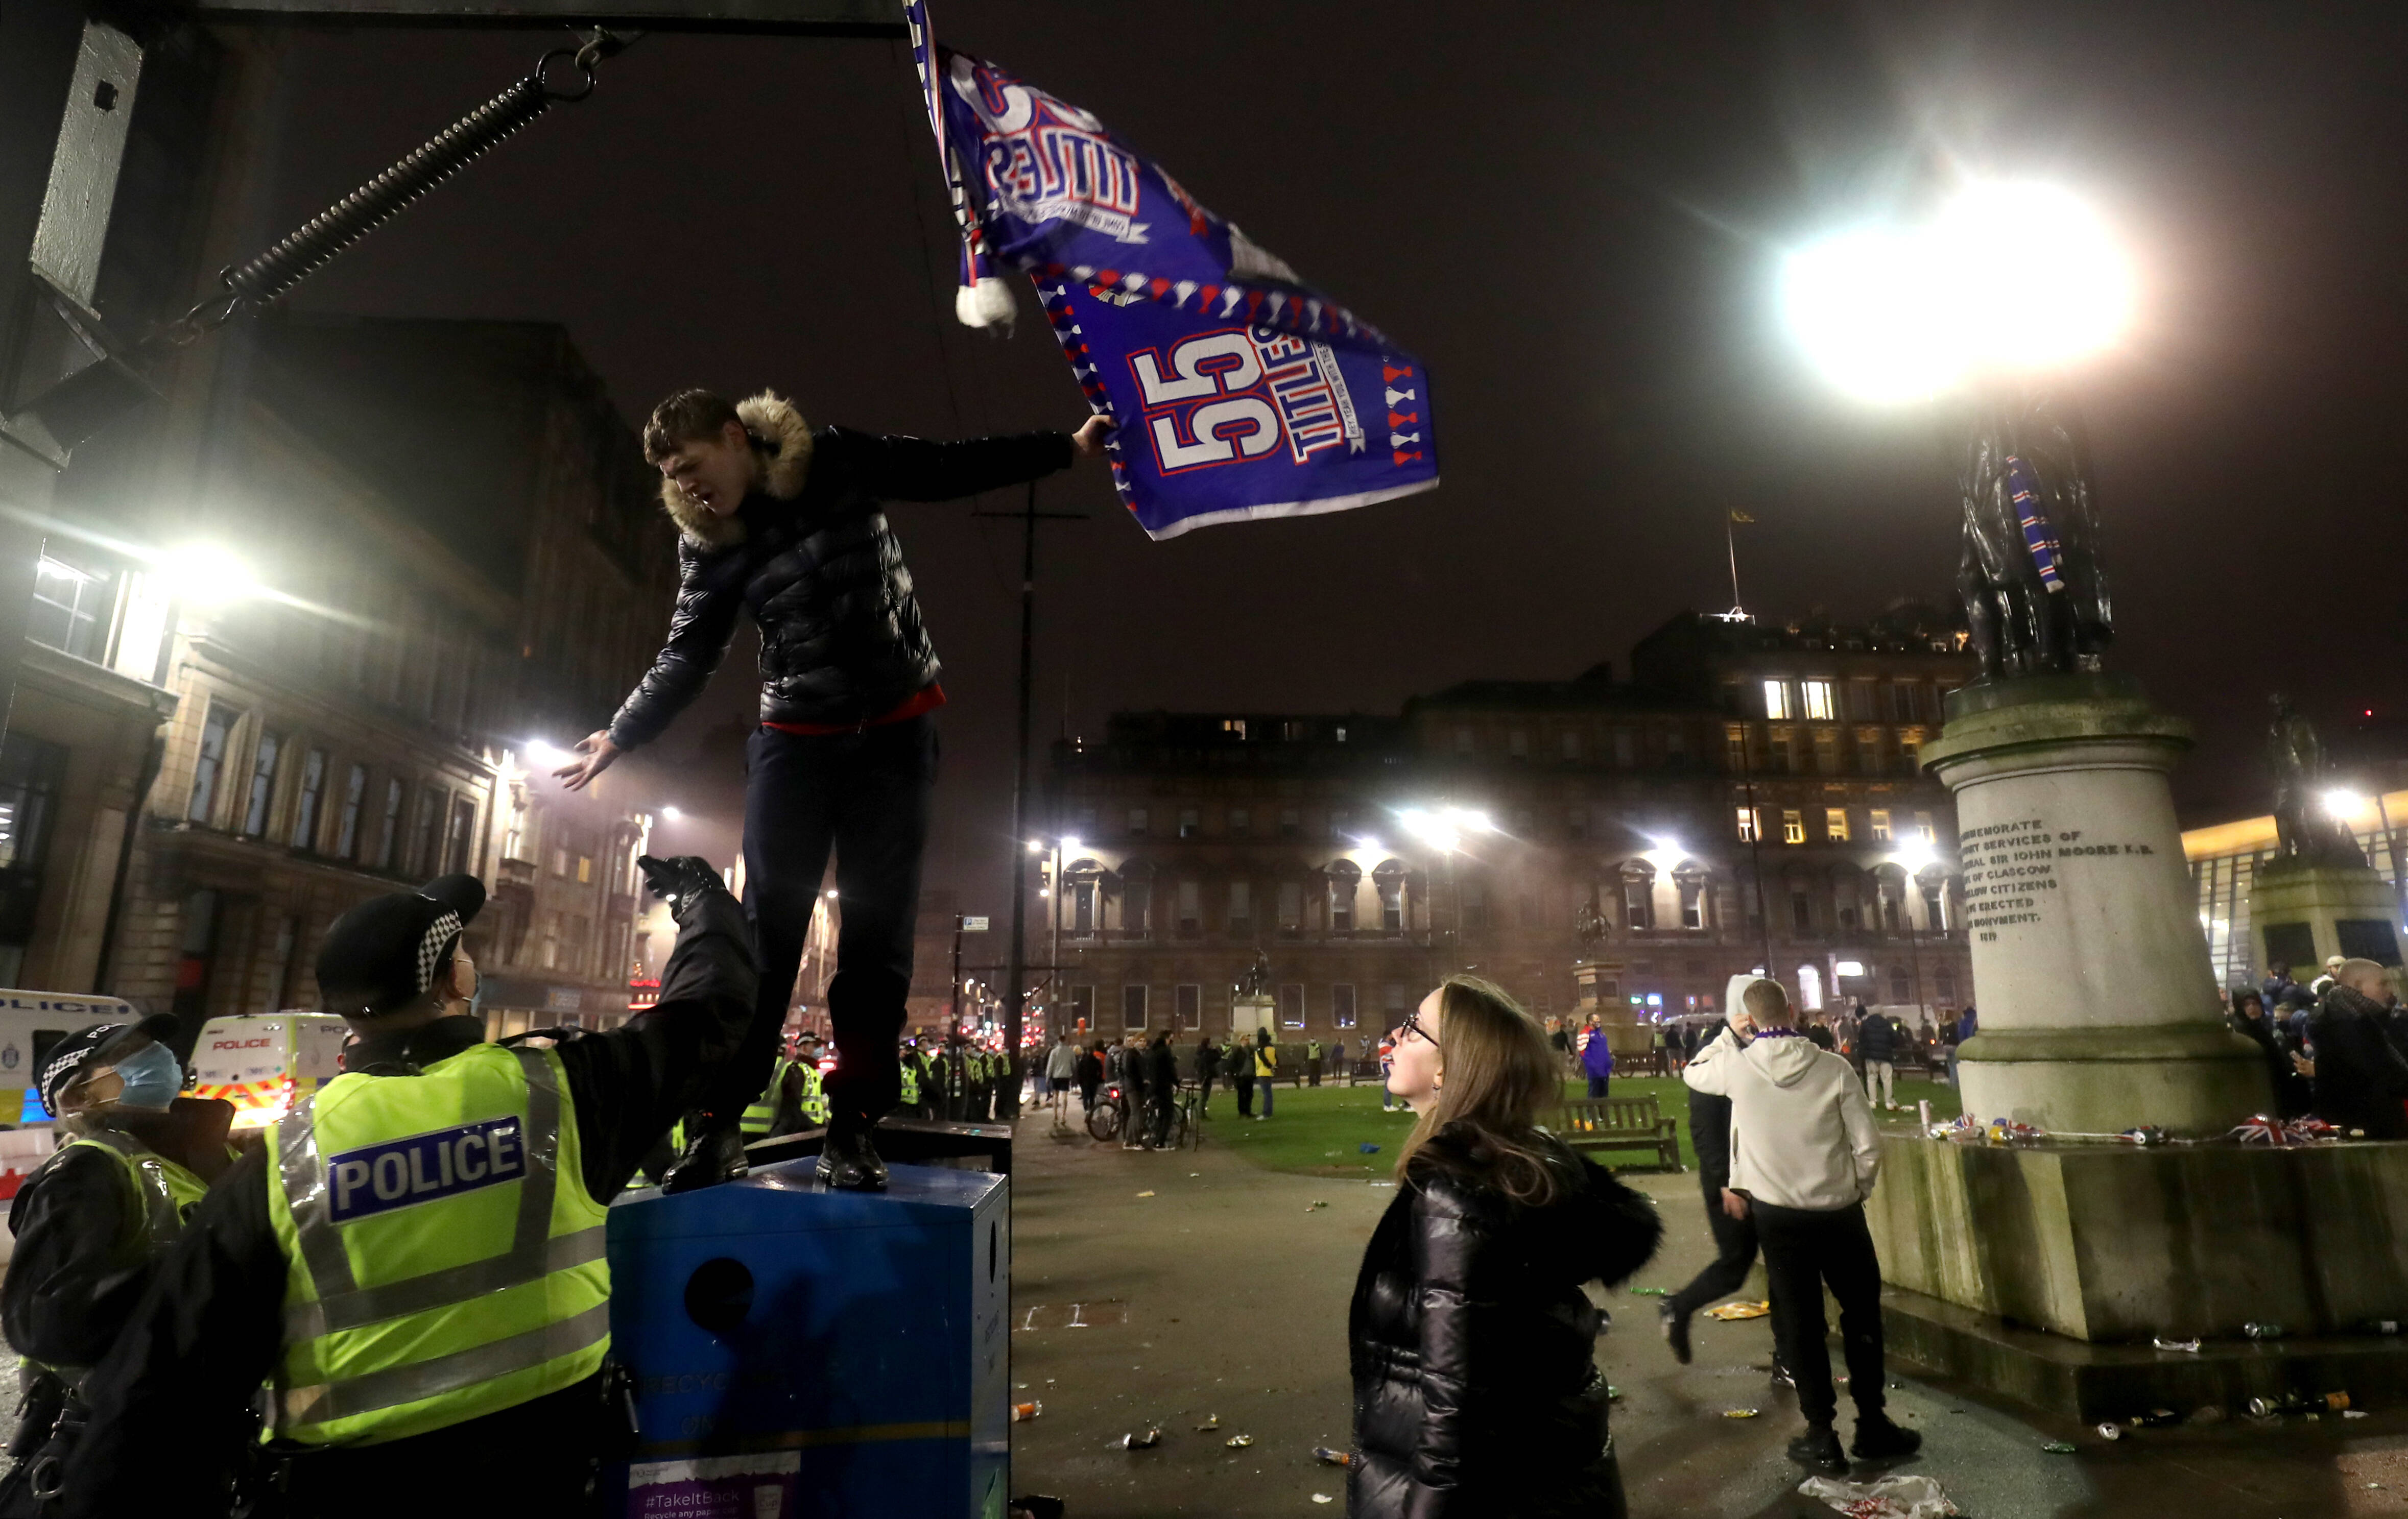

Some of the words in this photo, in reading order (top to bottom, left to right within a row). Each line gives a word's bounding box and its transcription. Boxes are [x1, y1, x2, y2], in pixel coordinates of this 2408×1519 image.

[1131, 329, 1282, 472] 55
[1984, 834, 2052, 851] SERVICES
[2059, 831, 2081, 841] OF
[1990, 854, 2009, 865] SIR
[2058, 845, 2118, 857] MOORE
[1990, 878, 2057, 895] CITIZENS
[1978, 898, 2034, 912] ERECTED
[0, 999, 113, 1014] LICE
[212, 1038, 272, 1050] POLICE
[335, 1126, 519, 1211] POLICE
[646, 1489, 740, 1508] #TakeItBack
[678, 1509, 694, 1518] any
